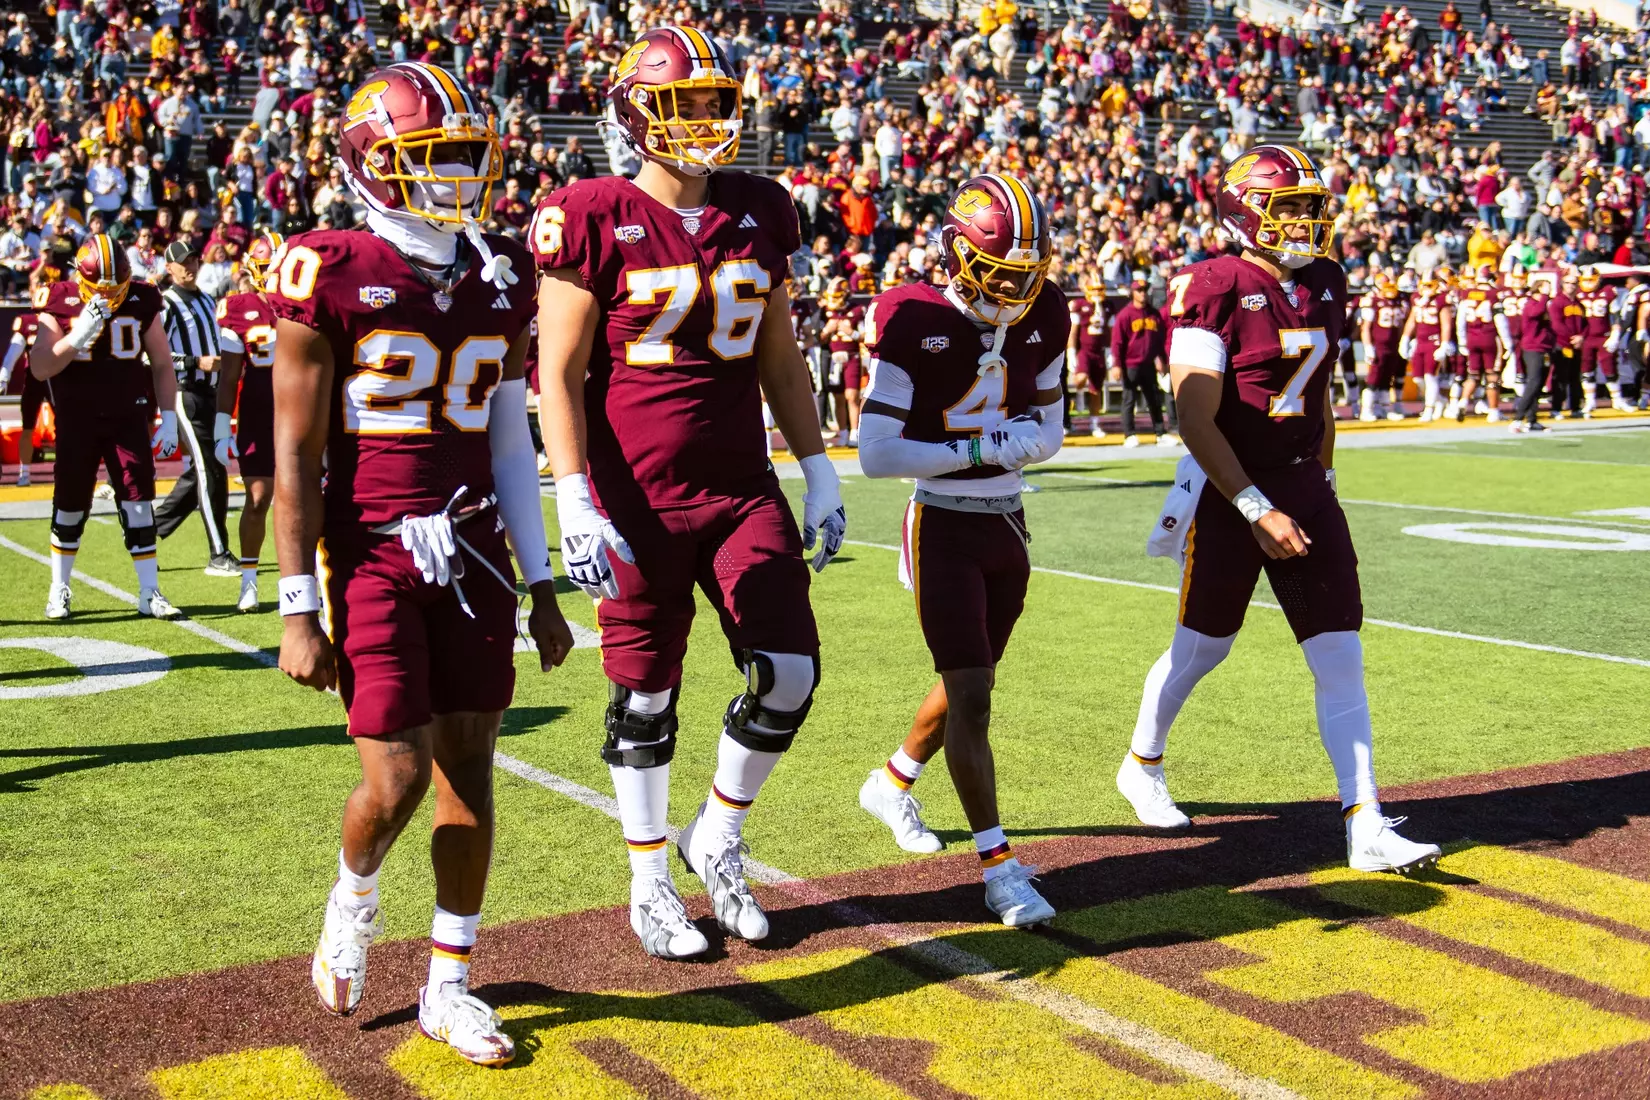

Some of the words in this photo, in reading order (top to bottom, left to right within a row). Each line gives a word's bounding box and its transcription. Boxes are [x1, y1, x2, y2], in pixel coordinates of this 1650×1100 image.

[528, 206, 566, 255] 6
[625, 259, 772, 366] 76
[1169, 273, 1193, 316] 7
[342, 329, 510, 433] 20
[943, 364, 1008, 437] 4
[1268, 326, 1330, 416] 7
